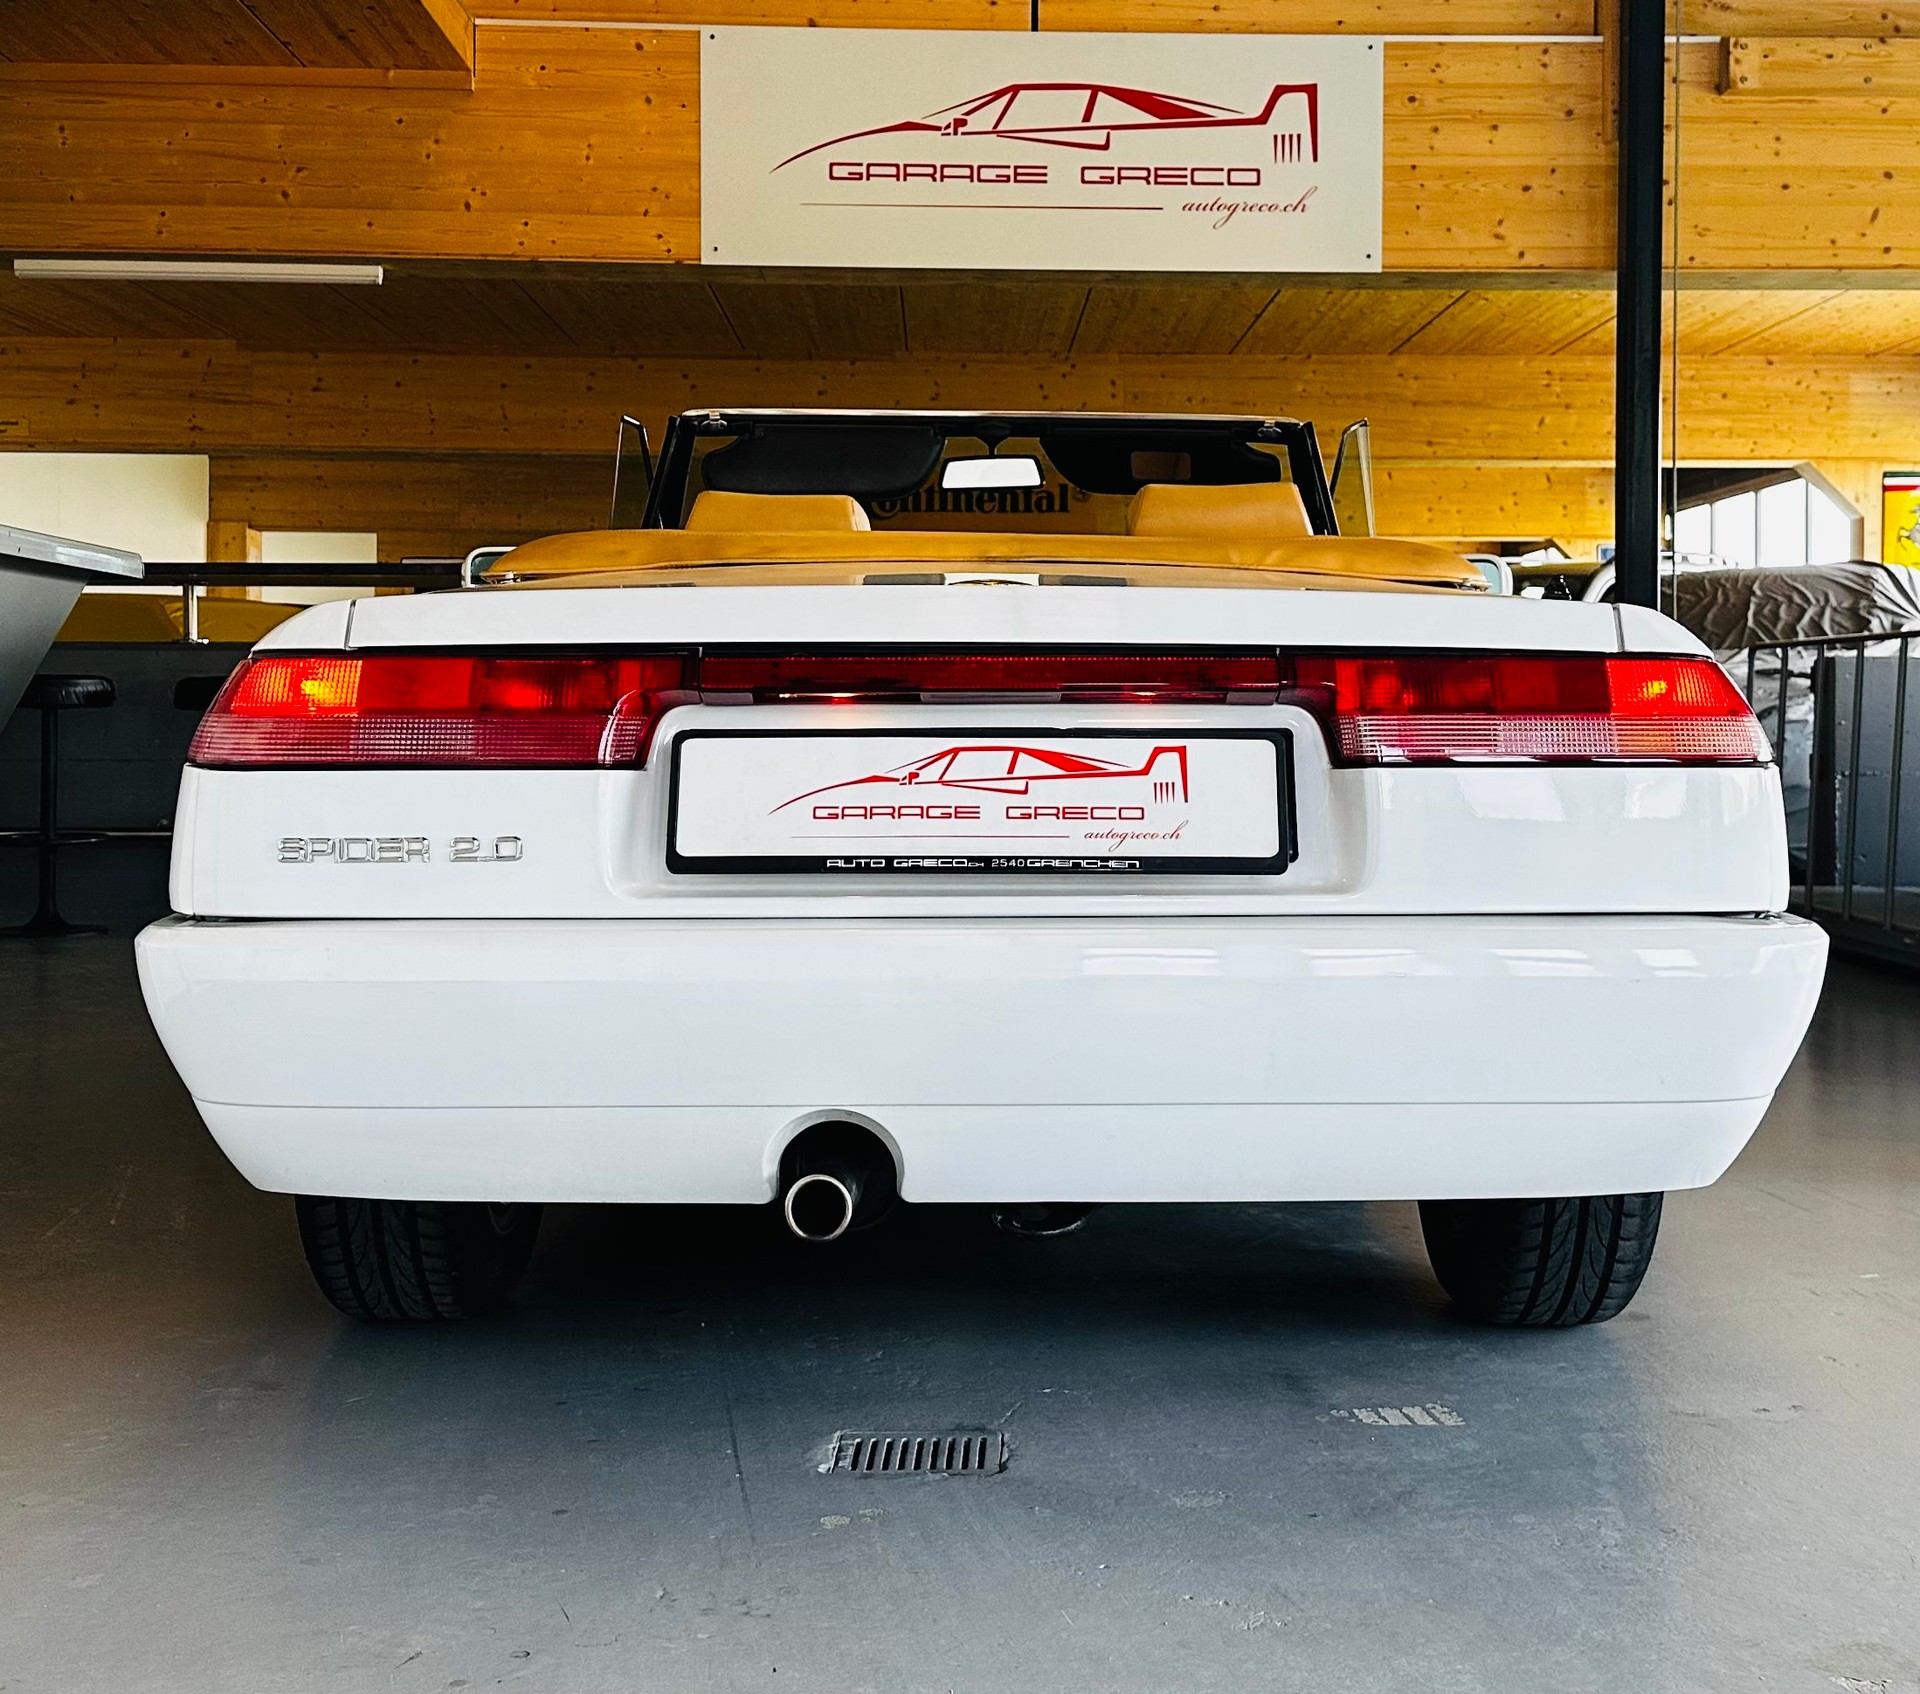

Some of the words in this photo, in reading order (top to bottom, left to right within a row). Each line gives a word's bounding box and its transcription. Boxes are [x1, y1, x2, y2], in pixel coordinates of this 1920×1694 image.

[828, 162, 1048, 184] GARAGE
[1080, 166, 1262, 186] GRECO
[1181, 187, 1317, 230] autogreco.ch
[812, 805, 981, 820] GARAGE
[1005, 805, 1146, 820] GRECO
[1084, 820, 1189, 852] autogreco.ch
[277, 837, 431, 863] SPIDER
[449, 836, 524, 862] 2.0
[826, 858, 886, 868] AUTO
[991, 858, 1025, 868] 2540
[1026, 858, 1140, 869] GRENCHEN
